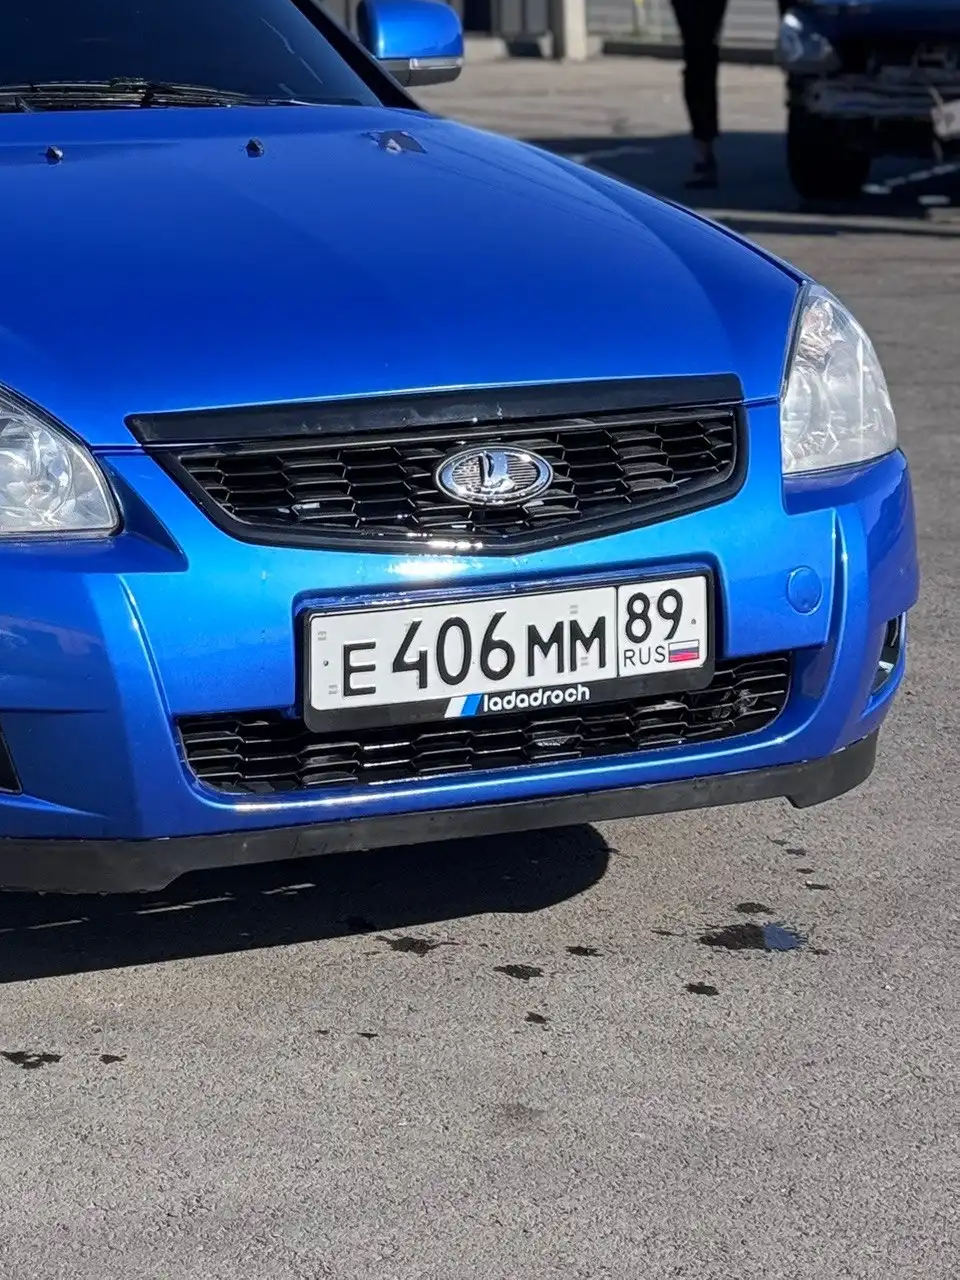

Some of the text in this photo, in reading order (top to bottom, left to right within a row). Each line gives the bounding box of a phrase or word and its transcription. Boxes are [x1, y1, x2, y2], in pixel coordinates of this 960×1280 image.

[624, 588, 683, 644] 89
[624, 646, 666, 669] RUS
[483, 684, 590, 713] ladadroch
